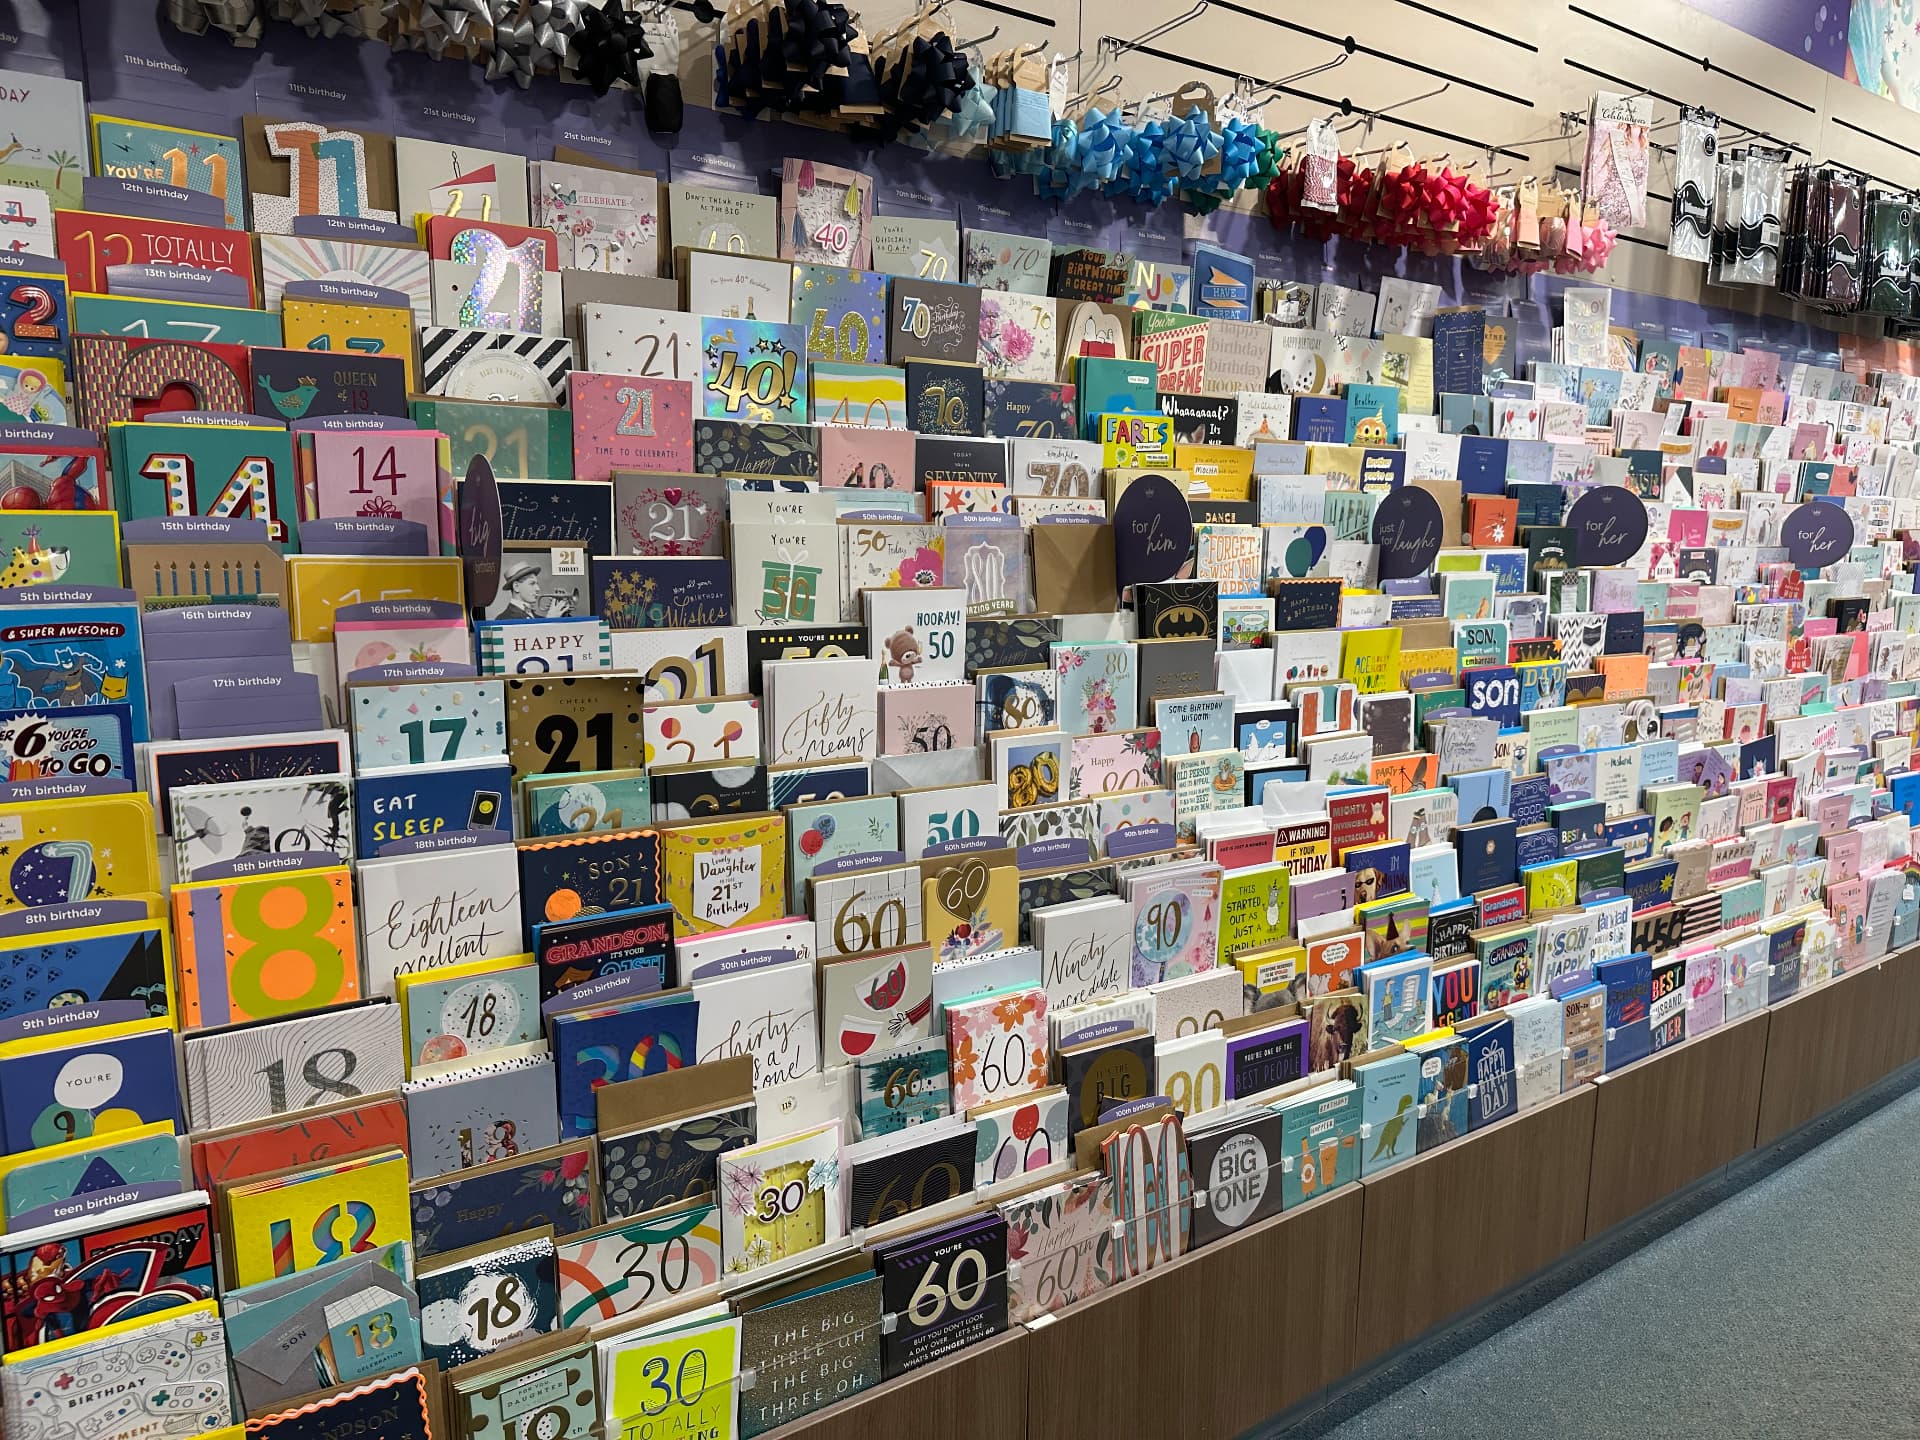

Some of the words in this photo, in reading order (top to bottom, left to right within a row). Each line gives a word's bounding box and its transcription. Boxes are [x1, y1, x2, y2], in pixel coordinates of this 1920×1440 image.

[124, 54, 144, 66] 11th
[146, 59, 189, 75] birthday
[288, 83, 307, 95] 11th
[308, 85, 347, 101] birthday
[424, 107, 440, 118] 21st
[442, 109, 476, 124] birthday
[564, 131, 580, 142] 21st
[581, 133, 612, 146] birthday
[106, 164, 164, 180] YOU'RE
[709, 157, 736, 170] birthday
[121, 182, 144, 194] 12th
[146, 185, 190, 202] birthday
[578, 195, 627, 208] CELEBRATE
[327, 219, 346, 230] 12th
[348, 221, 386, 234] birthday
[815, 223, 849, 252] 40
[142, 233, 234, 264] TOTALLY
[144, 268, 168, 280] 13th
[170, 270, 212, 283] birthday
[319, 284, 339, 295] 13th
[341, 286, 379, 299] birthday
[1212, 287, 1237, 299] HAVE
[901, 297, 931, 338] 70
[1149, 314, 1176, 332] You're
[807, 308, 869, 363] 40
[635, 332, 679, 379] 21
[333, 371, 377, 386] QUEEN
[708, 350, 798, 413] 40!
[926, 386, 965, 427] 70
[1006, 401, 1031, 415] Happy
[181, 416, 205, 426] 14th
[208, 416, 250, 427] birthday
[323, 420, 341, 428] 14th
[344, 419, 384, 431] birthday
[1107, 418, 1168, 444] FARTS
[596, 447, 614, 457] TIME
[620, 448, 630, 457] TO
[636, 448, 678, 459] CELEBRATE!
[924, 470, 997, 484] SEVENTY
[139, 453, 288, 542] 14
[768, 502, 804, 514] YOU'RE
[649, 503, 701, 541] 21
[1206, 512, 1236, 523] DANCE
[161, 522, 185, 532] 15th
[187, 521, 230, 533] birthday
[334, 522, 355, 531] 15th
[357, 521, 395, 533] birthday
[1132, 520, 1149, 533] for
[1146, 513, 1177, 555] him
[1379, 523, 1394, 536] just
[1586, 518, 1602, 532] for
[1599, 514, 1629, 550] her
[771, 534, 806, 546] YOU'RE
[1381, 536, 1393, 546] for
[1391, 519, 1435, 563] laughs
[1798, 529, 1812, 540] for
[1810, 526, 1837, 553] her
[559, 552, 576, 565] 21
[558, 566, 579, 574] TODAY!
[20, 591, 40, 601] 5th
[43, 590, 93, 602] birthday
[182, 611, 206, 620] 16th
[208, 609, 252, 621] birthday
[371, 605, 391, 615] 16th
[393, 604, 431, 615] birthday
[917, 610, 961, 627] HOORAY!
[513, 635, 584, 652] HAPPY
[798, 634, 825, 643] YOU'RE
[929, 631, 955, 660] 50
[384, 668, 400, 677] 17th
[402, 666, 444, 678] birthday
[1471, 677, 1519, 711] son
[1169, 705, 1188, 713] SOME
[1190, 702, 1223, 713] BIRTHDAY
[1181, 713, 1209, 722] WISDOM
[60, 738, 98, 752] GOOD
[535, 712, 614, 774] 21
[1091, 755, 1115, 768] Happy
[11, 786, 31, 797] 7th
[34, 783, 87, 797] birthday
[373, 794, 417, 814] EAT
[373, 817, 446, 841] SLEEP
[928, 808, 980, 848] 50
[1289, 824, 1327, 842] WARNING!
[415, 838, 440, 849] 18th
[441, 835, 478, 848] birthday
[945, 842, 958, 851] 60th
[960, 840, 987, 850] birthday
[1048, 842, 1071, 853] birthday
[1290, 848, 1297, 857] IF
[1299, 846, 1315, 856] YOUR
[232, 862, 256, 873] 18th
[258, 856, 303, 871] birthday
[700, 861, 757, 879] Daughter
[711, 856, 731, 866] Lovely
[946, 863, 986, 910] 60
[1238, 884, 1256, 895] THIS
[705, 901, 749, 918] Birthday
[1226, 896, 1261, 913] STARTED
[1484, 899, 1519, 913] Grandson,
[834, 890, 907, 955] 60
[1147, 900, 1182, 951] 90
[1552, 925, 1589, 957] SON
[610, 950, 624, 959] IT'S
[625, 947, 645, 956] YOUR
[1489, 941, 1528, 966] GRANDSON
[720, 959, 739, 972] 30th
[741, 954, 772, 969] birthday
[572, 986, 595, 1000] 30th
[596, 976, 632, 996] birthday
[871, 960, 907, 1011] 60
[1651, 966, 1682, 1002] BEST
[22, 1018, 45, 1030] 9th
[48, 1008, 100, 1026] birthday
[461, 993, 497, 1038] 18
[1077, 1029, 1095, 1041] 100th
[1096, 1024, 1118, 1039] birthday
[1655, 1015, 1682, 1050] EVER
[1244, 1052, 1263, 1062] YOU'RE
[1264, 1049, 1275, 1058] ONE
[1277, 1046, 1284, 1055] OF
[981, 1034, 1026, 1093] 60
[66, 1073, 112, 1087] YOU'RE
[884, 1067, 924, 1109] 60
[1115, 1107, 1131, 1118] 100th
[1131, 1101, 1155, 1115] birthday
[1482, 1088, 1509, 1117] DAY
[1218, 1148, 1258, 1184] BIG
[758, 1180, 804, 1224] 30
[1214, 1174, 1262, 1213] ONE
[54, 1201, 83, 1217] teen
[86, 1190, 139, 1210] birthday
[934, 1243, 962, 1257] YOU'RE
[615, 1236, 690, 1316] 30
[907, 1249, 988, 1327] 60
[467, 1275, 522, 1341] 18
[350, 1310, 398, 1357] 18
[914, 1334, 927, 1346] BUT
[928, 1330, 941, 1342] YOU
[943, 1321, 963, 1338] DON'T
[964, 1313, 985, 1328] LOOK
[283, 1330, 307, 1351] SON
[903, 1351, 929, 1369] WHAT'S
[930, 1339, 965, 1358] YOUNGER
[966, 1333, 984, 1346] THAN
[985, 1326, 995, 1337] 60
[357, 1351, 403, 1375] CELEBRATION
[518, 1385, 533, 1396] FOR
[641, 1348, 707, 1416] 30
[68, 1378, 147, 1408] BIRTHDAY
[507, 1381, 564, 1407] DAUGHTER
